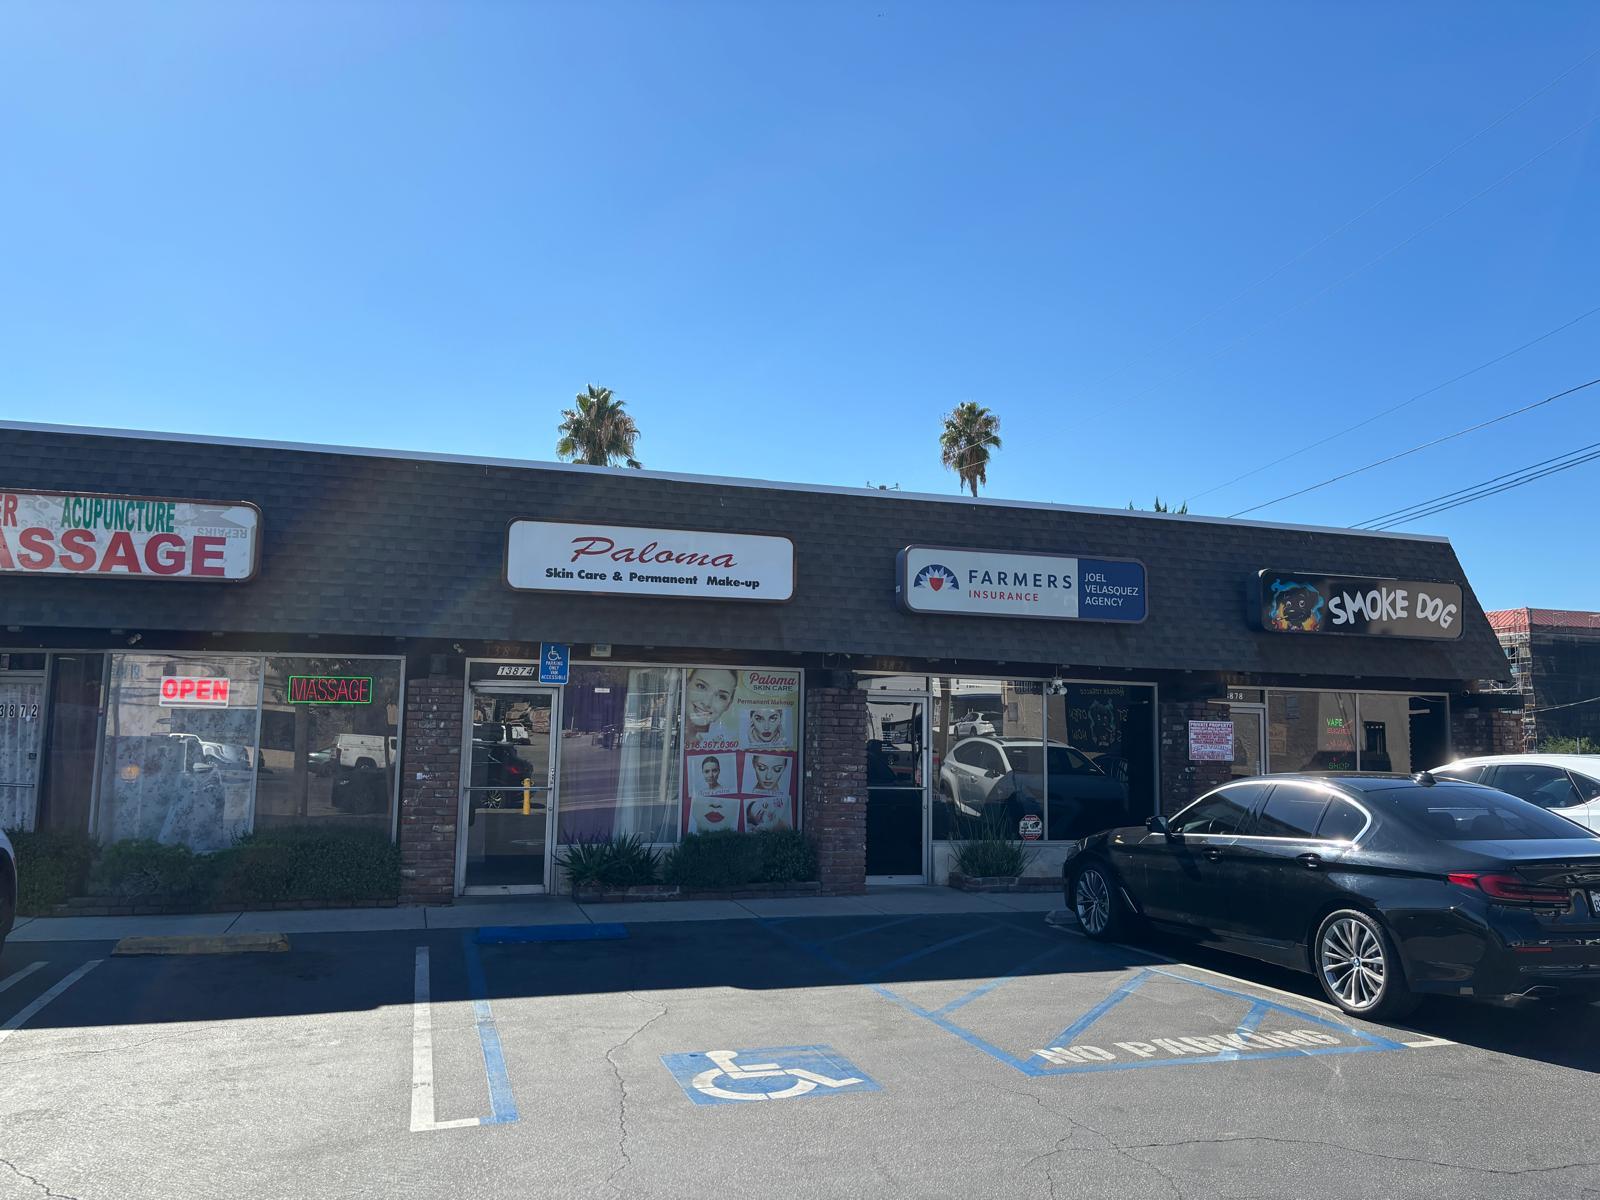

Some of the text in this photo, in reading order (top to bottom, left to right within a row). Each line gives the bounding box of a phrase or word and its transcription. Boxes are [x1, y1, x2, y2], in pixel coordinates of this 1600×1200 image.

[0, 494, 176, 533] R ACUPUNCTURE
[571, 536, 737, 568] Paloma
[545, 567, 760, 590] Skin Care & Permanent Make-up
[968, 569, 1073, 589] FARMERS
[1085, 572, 1107, 583] JOEL
[968, 589, 1040, 602] INSURANCE
[1085, 584, 1139, 596] VELASQUEZ
[1085, 596, 1123, 607] AGENCY
[1328, 587, 1457, 629] SMOKE DOG
[750, 672, 796, 685] Paloma
[162, 679, 228, 700] OPEN
[292, 678, 369, 702] MASSAGE
[1327, 718, 1343, 727] VAPE
[1328, 762, 1350, 770] SHOP
[1036, 1029, 1341, 1064] NO PARKING
